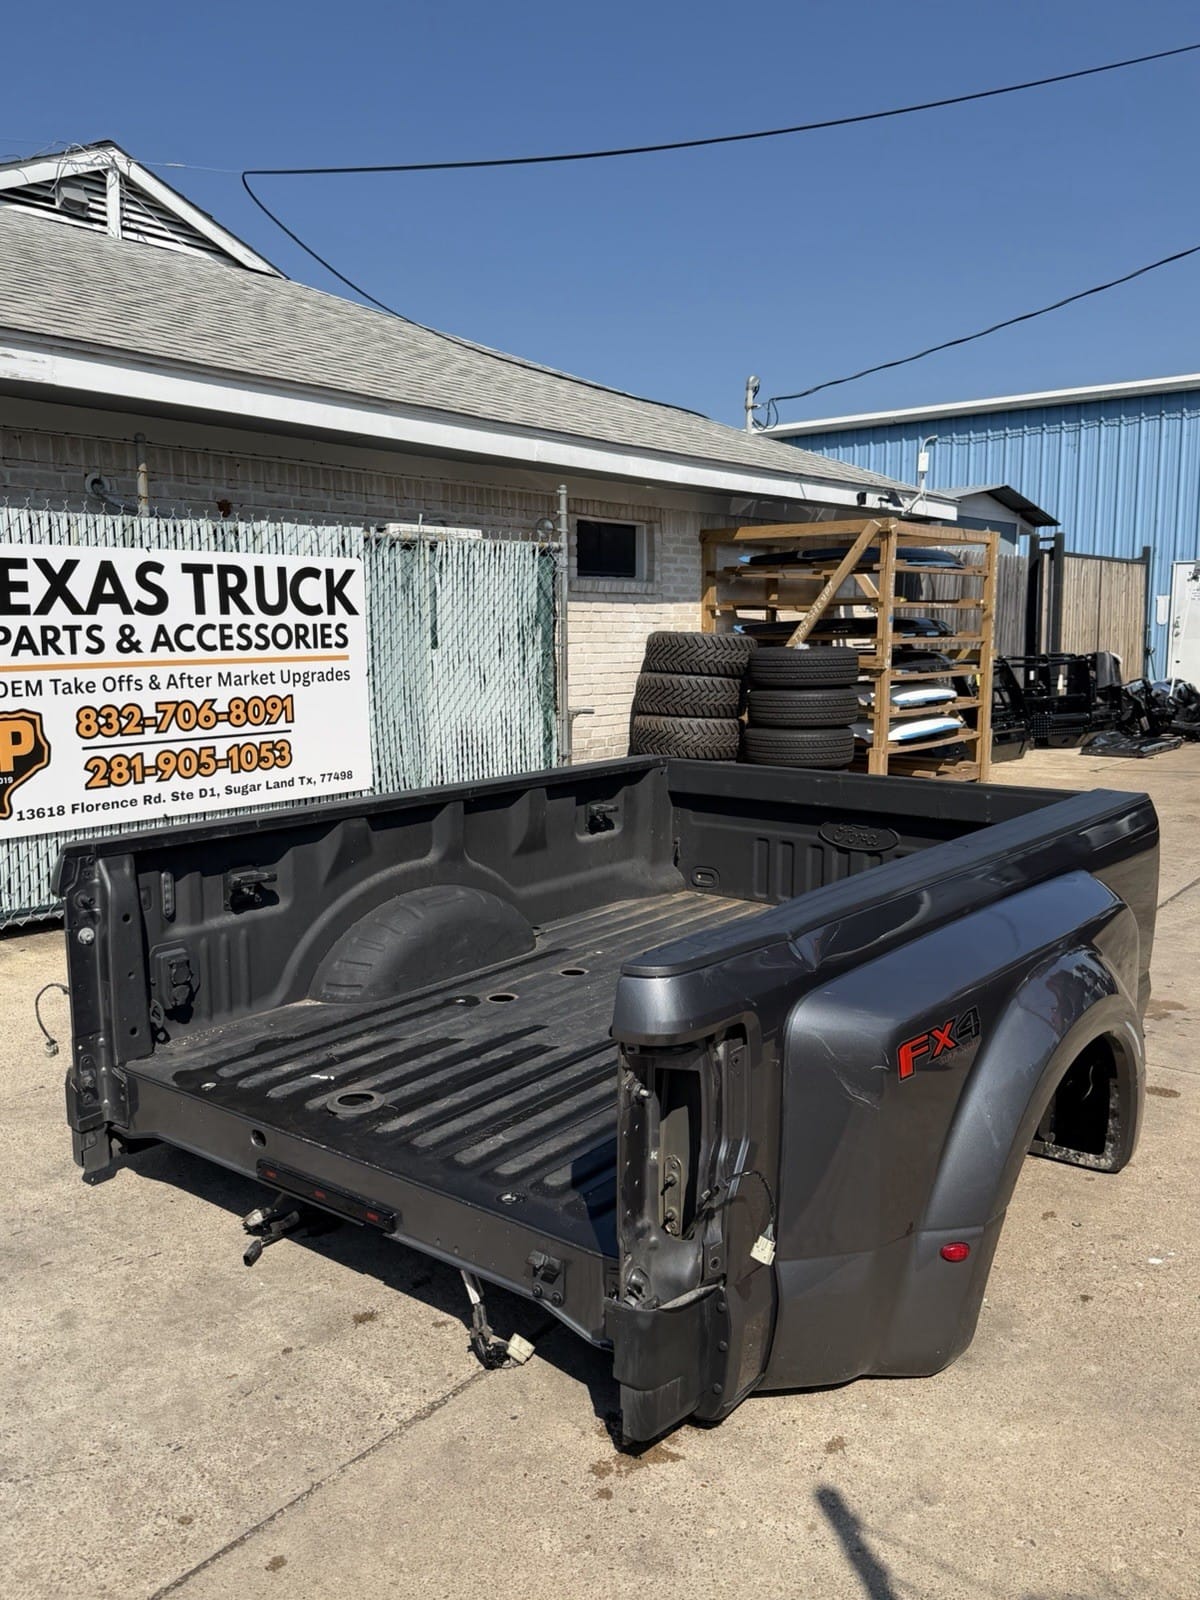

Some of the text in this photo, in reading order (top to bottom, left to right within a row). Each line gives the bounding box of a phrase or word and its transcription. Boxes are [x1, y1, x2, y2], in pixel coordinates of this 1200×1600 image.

[181, 562, 360, 617] TRUCK
[115, 623, 144, 654] &
[150, 622, 349, 653] ACCESSORIES
[49, 677, 97, 695] Take
[102, 674, 144, 692] Offs
[148, 674, 161, 690] &
[166, 670, 212, 690] After
[217, 670, 276, 687] Market
[280, 667, 351, 687] Upgrades
[76, 695, 294, 739] 832-706-8091
[84, 739, 292, 790] 281-905-1053
[16, 770, 354, 821] 13618 Florence Rd. Ste D1, Sugar Land Tx, 77498
[897, 1005, 981, 1082] FX4
